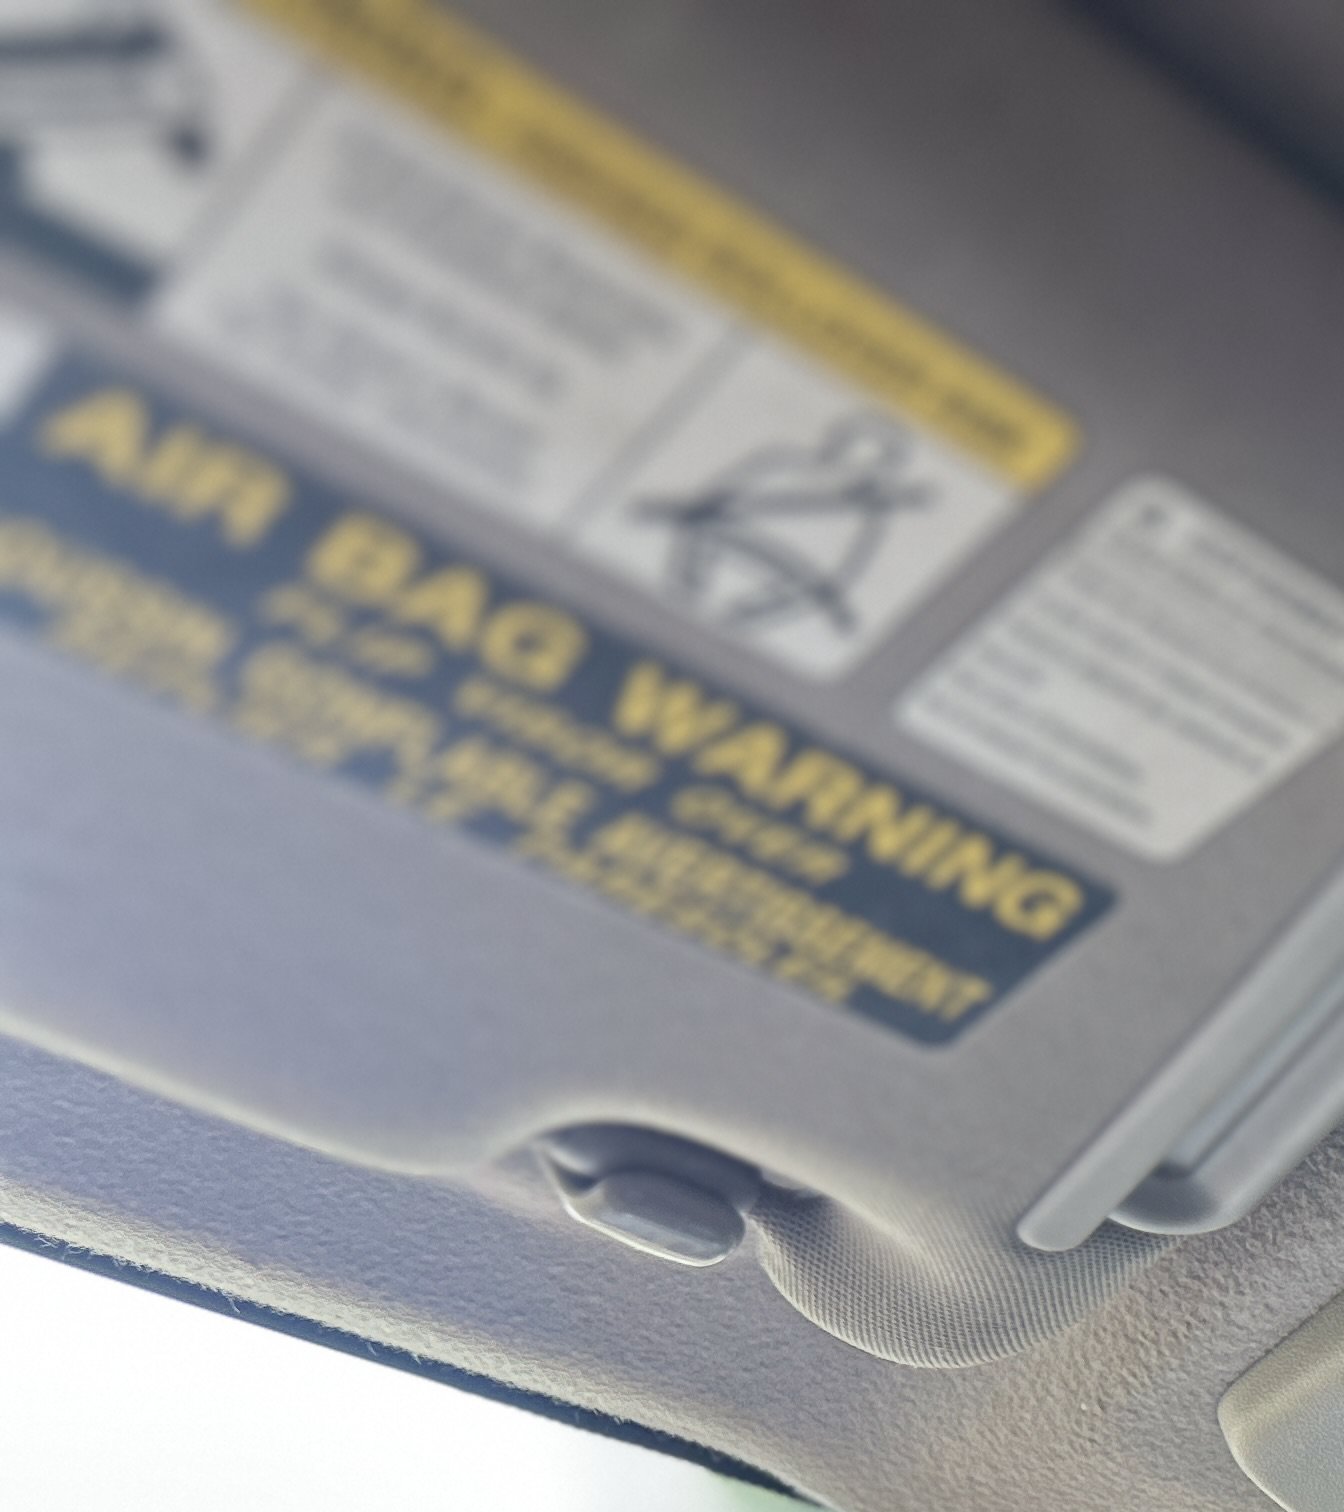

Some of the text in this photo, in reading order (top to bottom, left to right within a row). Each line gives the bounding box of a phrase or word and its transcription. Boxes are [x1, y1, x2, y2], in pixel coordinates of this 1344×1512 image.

[38, 388, 290, 548] AIR
[308, 510, 590, 692] BAG
[612, 662, 1085, 941] WARNING
